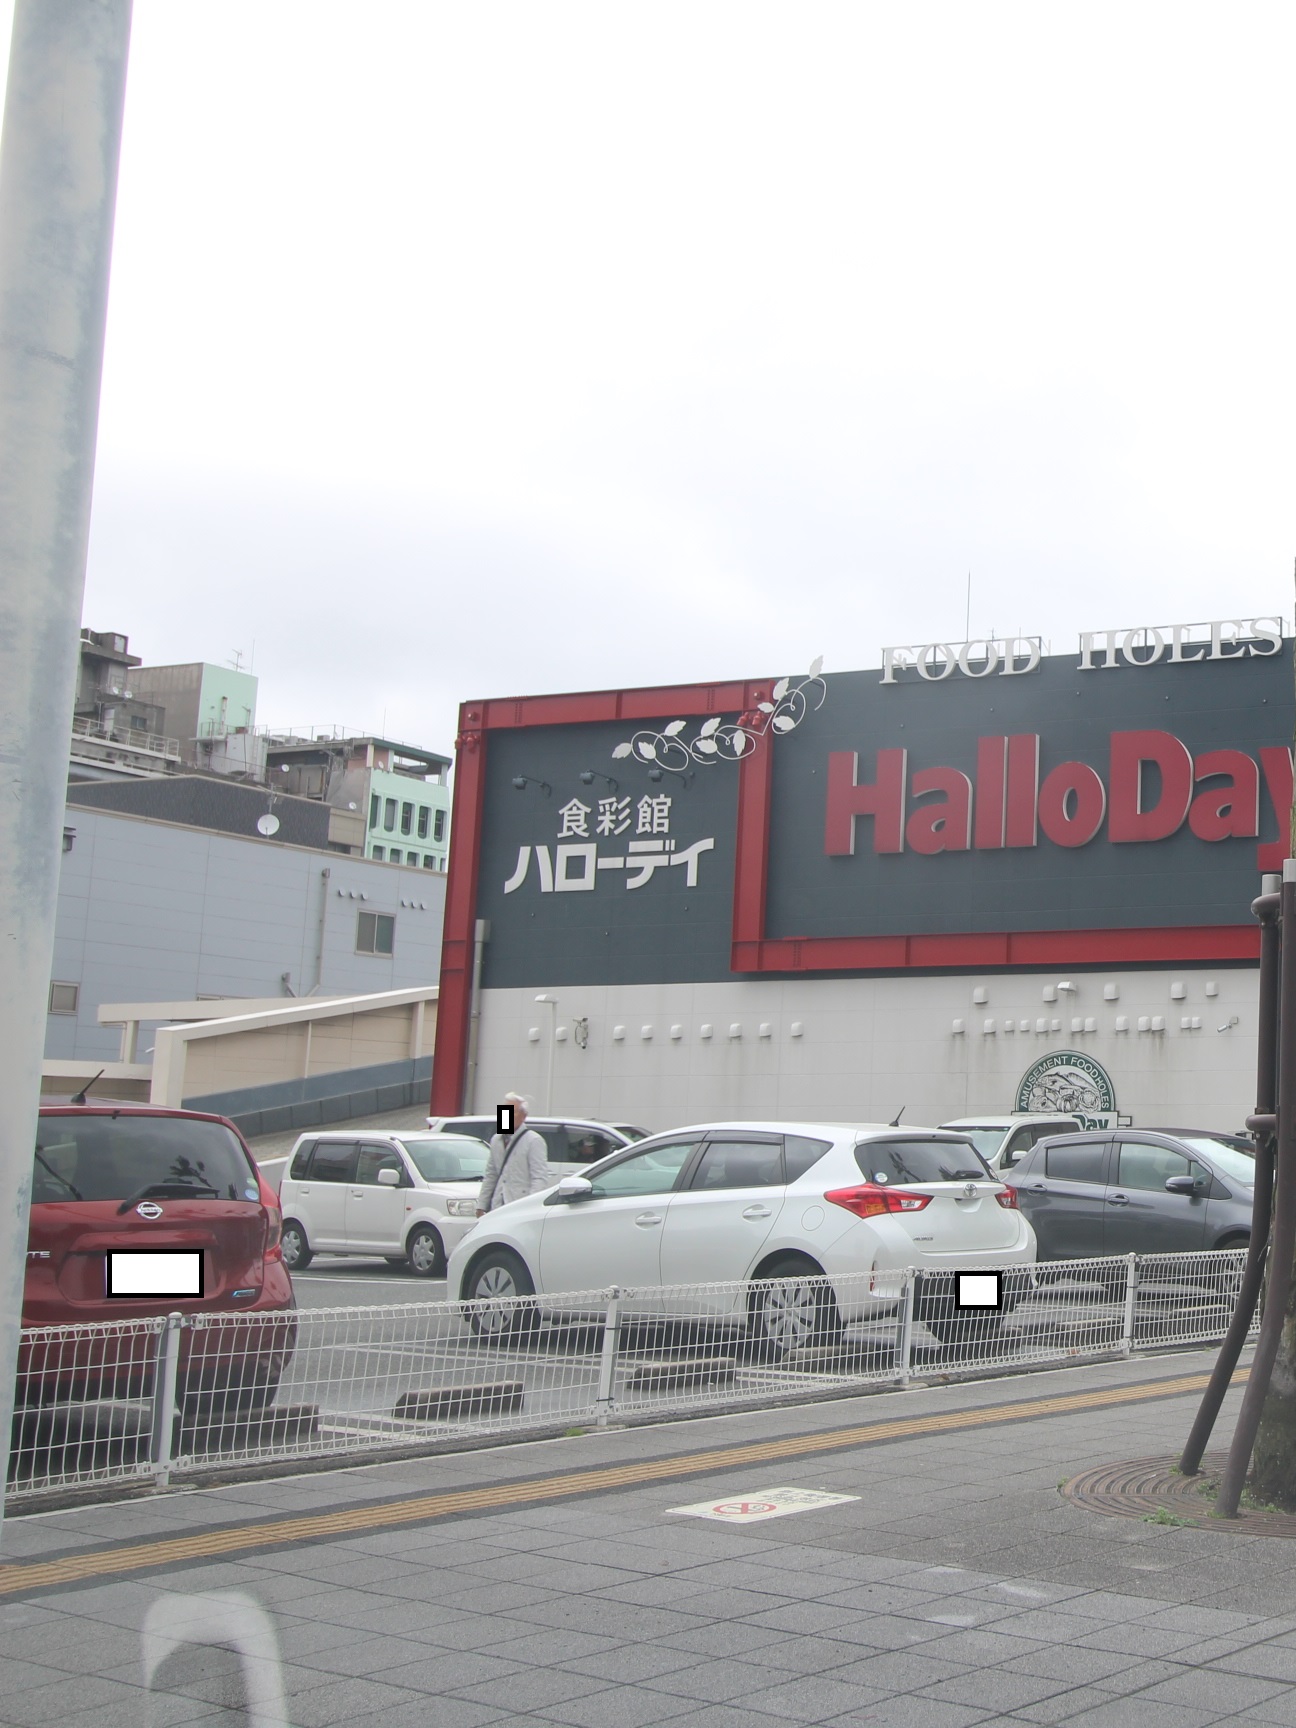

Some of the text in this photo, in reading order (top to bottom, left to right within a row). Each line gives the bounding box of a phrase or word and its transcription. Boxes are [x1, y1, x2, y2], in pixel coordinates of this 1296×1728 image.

[878, 616, 1284, 685] FOOD HOLES
[557, 793, 673, 839] 食彩館
[503, 837, 715, 894] ハローデイ
[1020, 1055, 1110, 1109] AMUSEMENT FOOD HOLES
[28, 1251, 51, 1259] TE
